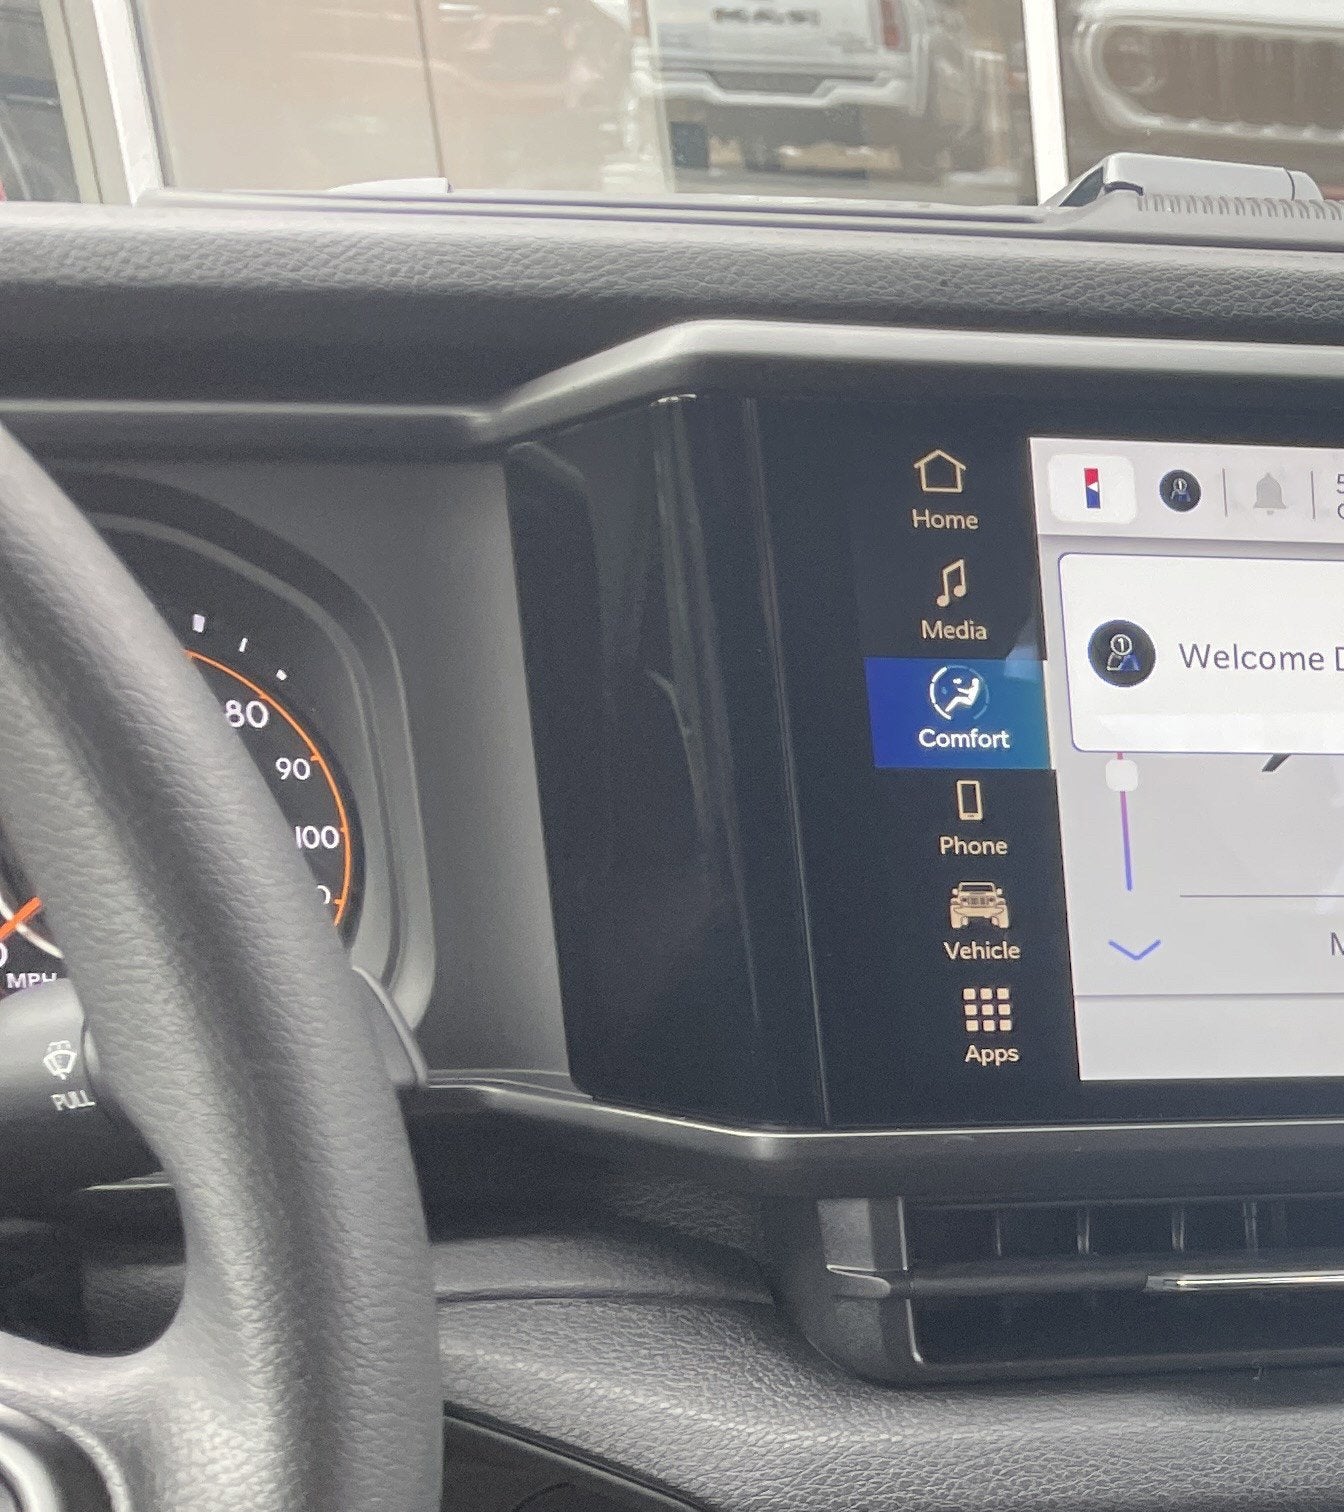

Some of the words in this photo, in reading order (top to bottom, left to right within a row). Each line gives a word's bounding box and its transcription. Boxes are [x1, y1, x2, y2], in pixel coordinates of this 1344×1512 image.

[912, 509, 979, 531] Home
[920, 620, 988, 641] Media
[1178, 642, 1325, 672] Welcome
[225, 700, 270, 730] 80
[918, 726, 1011, 752] Comfort
[275, 757, 312, 781] 90
[295, 826, 340, 850] 100
[940, 835, 1009, 857] Phone
[943, 939, 1021, 962] Vehicle
[964, 1044, 1021, 1067] Apps
[51, 1091, 96, 1112] PULL
